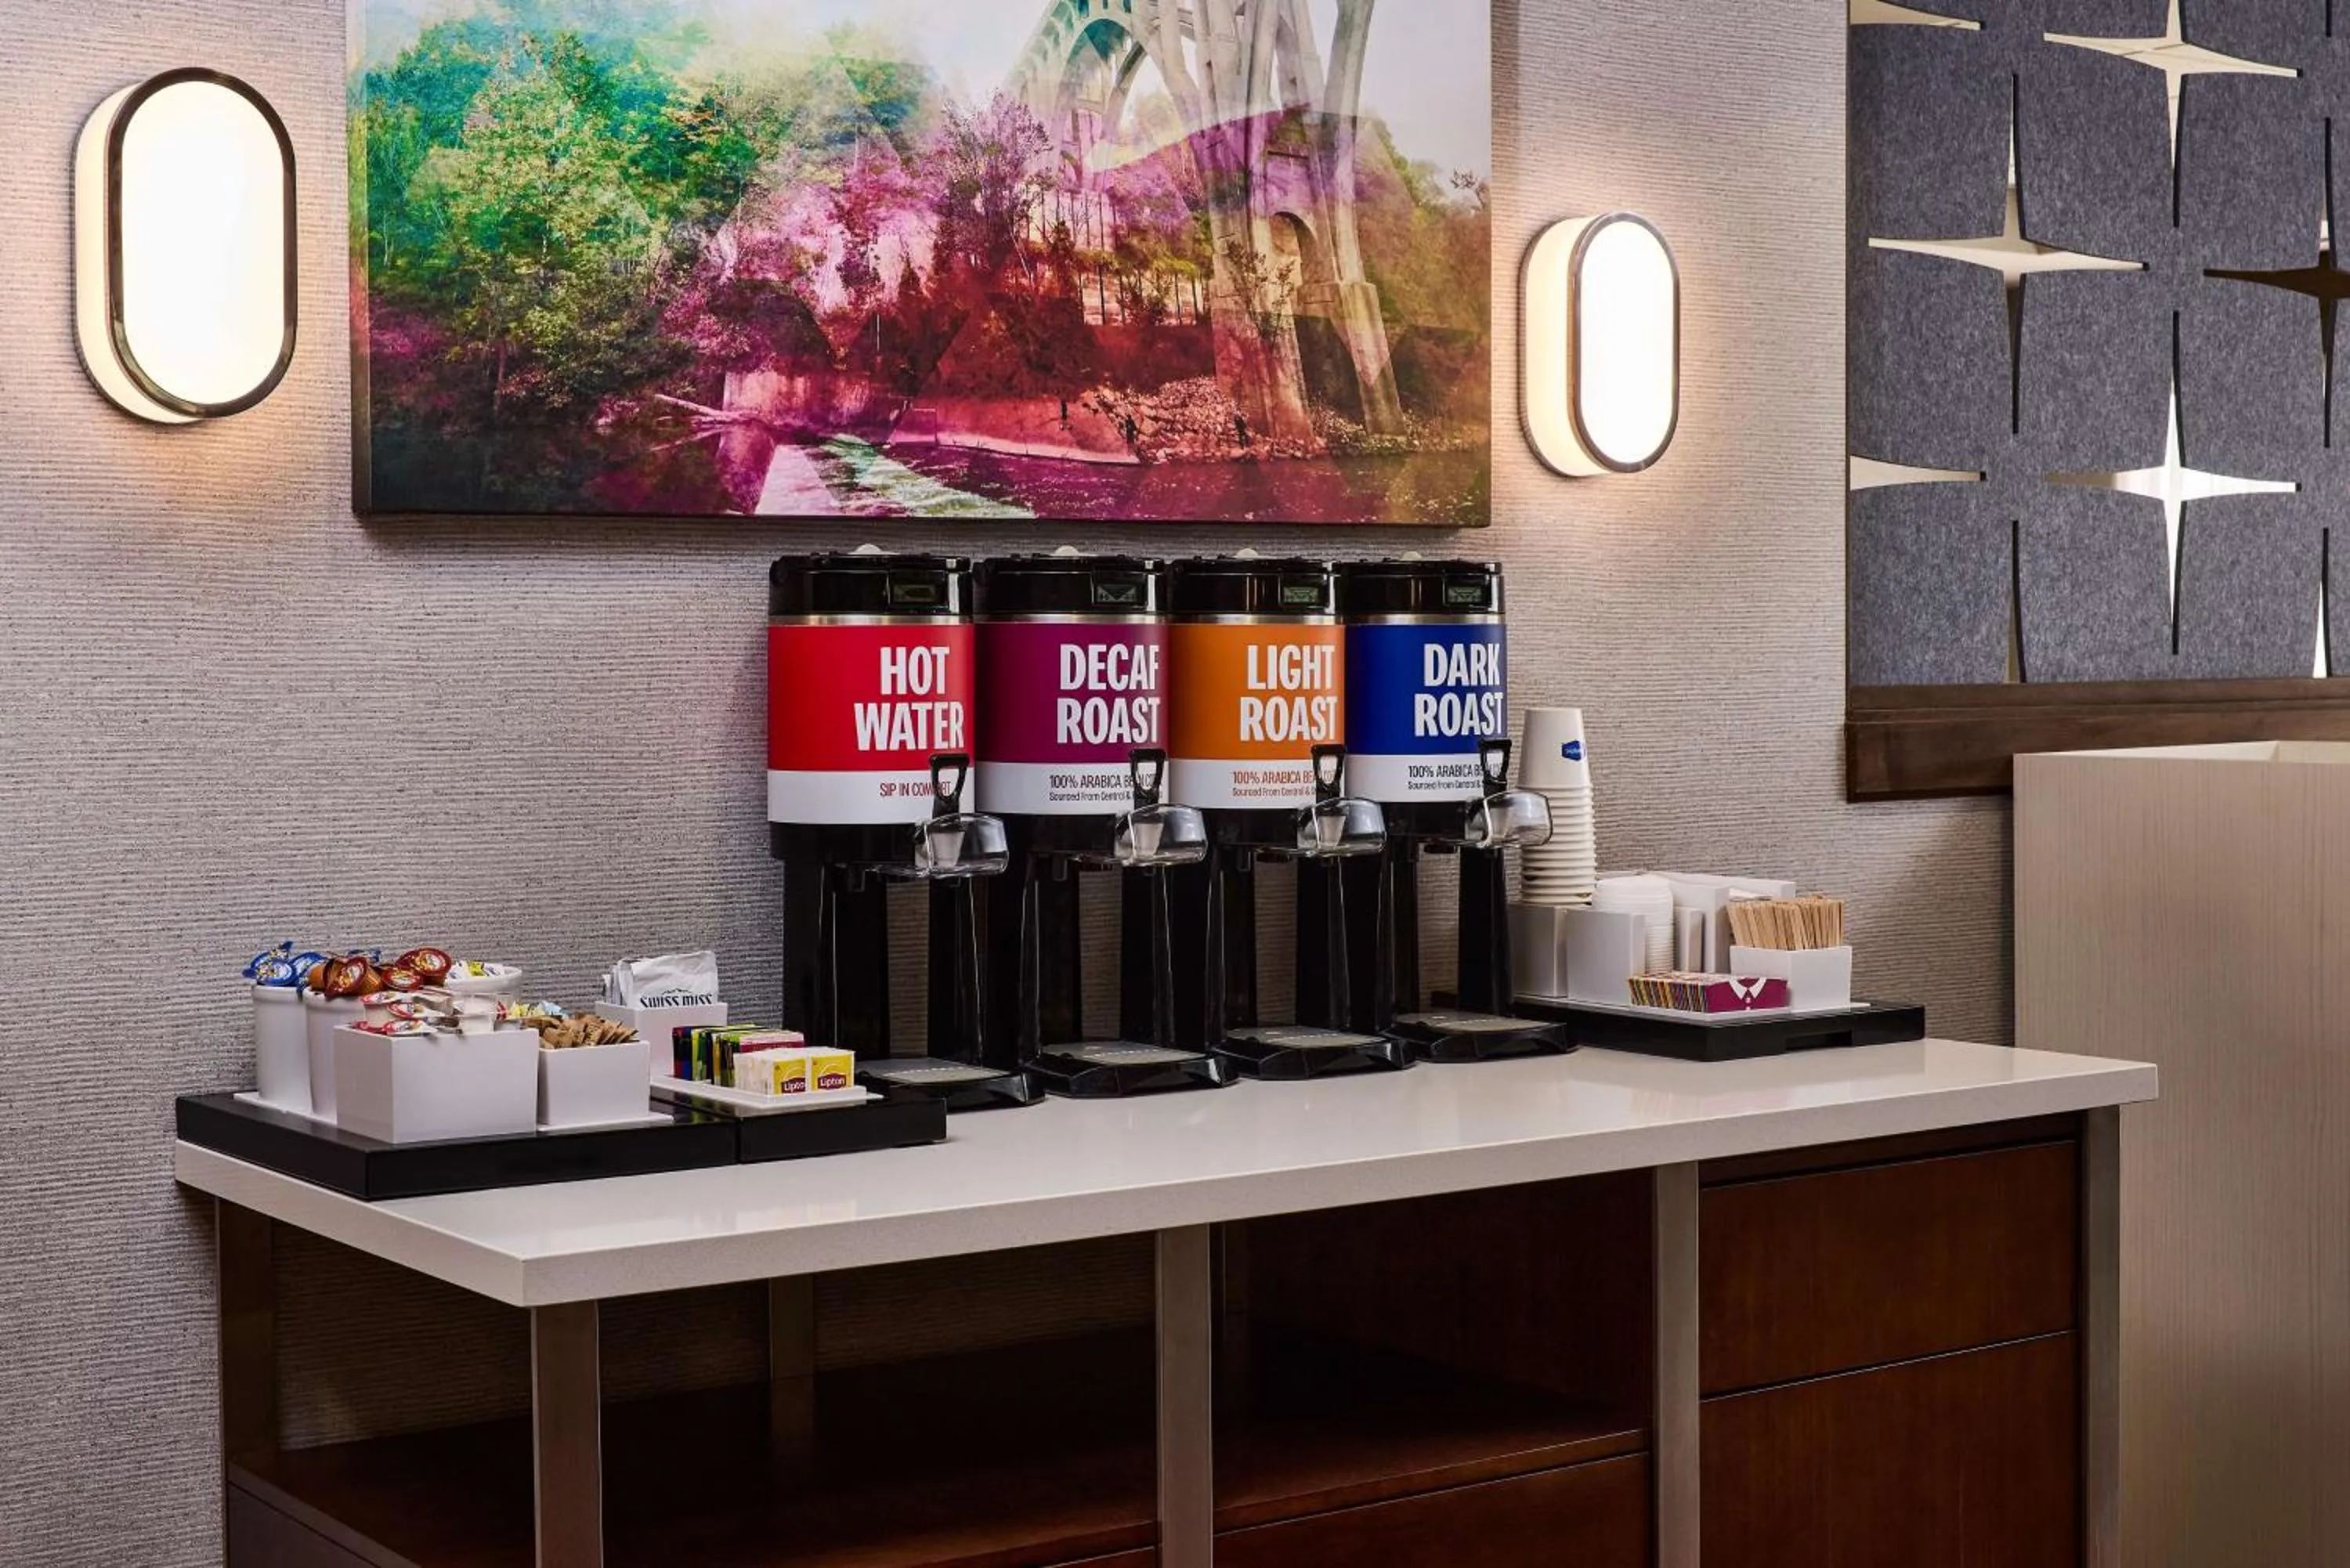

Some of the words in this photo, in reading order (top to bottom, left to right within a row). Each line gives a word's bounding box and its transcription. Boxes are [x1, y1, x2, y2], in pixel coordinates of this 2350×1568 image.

[880, 646, 949, 695] HOT
[1060, 643, 1159, 691] DECAF
[1248, 645, 1335, 689] LIGHT
[1424, 643, 1500, 686] DARK
[854, 702, 964, 750] WATER
[1057, 696, 1161, 744] ROAST
[1240, 695, 1338, 742] ROAST
[1414, 692, 1503, 737] ROAST
[880, 782, 896, 797] SIP
[898, 782, 909, 796] IN
[911, 781, 951, 797] COMRT
[1049, 774, 1079, 789] 100%
[1080, 774, 1123, 789] ARABICA
[1232, 770, 1260, 784] 100%
[1262, 770, 1301, 784] ARABICA
[1232, 786, 1262, 797] Sourced
[1408, 764, 1434, 778] 100%
[1436, 764, 1473, 778] ARABICA
[784, 1081, 806, 1093] Lipto
[820, 1076, 845, 1088] Lipton
